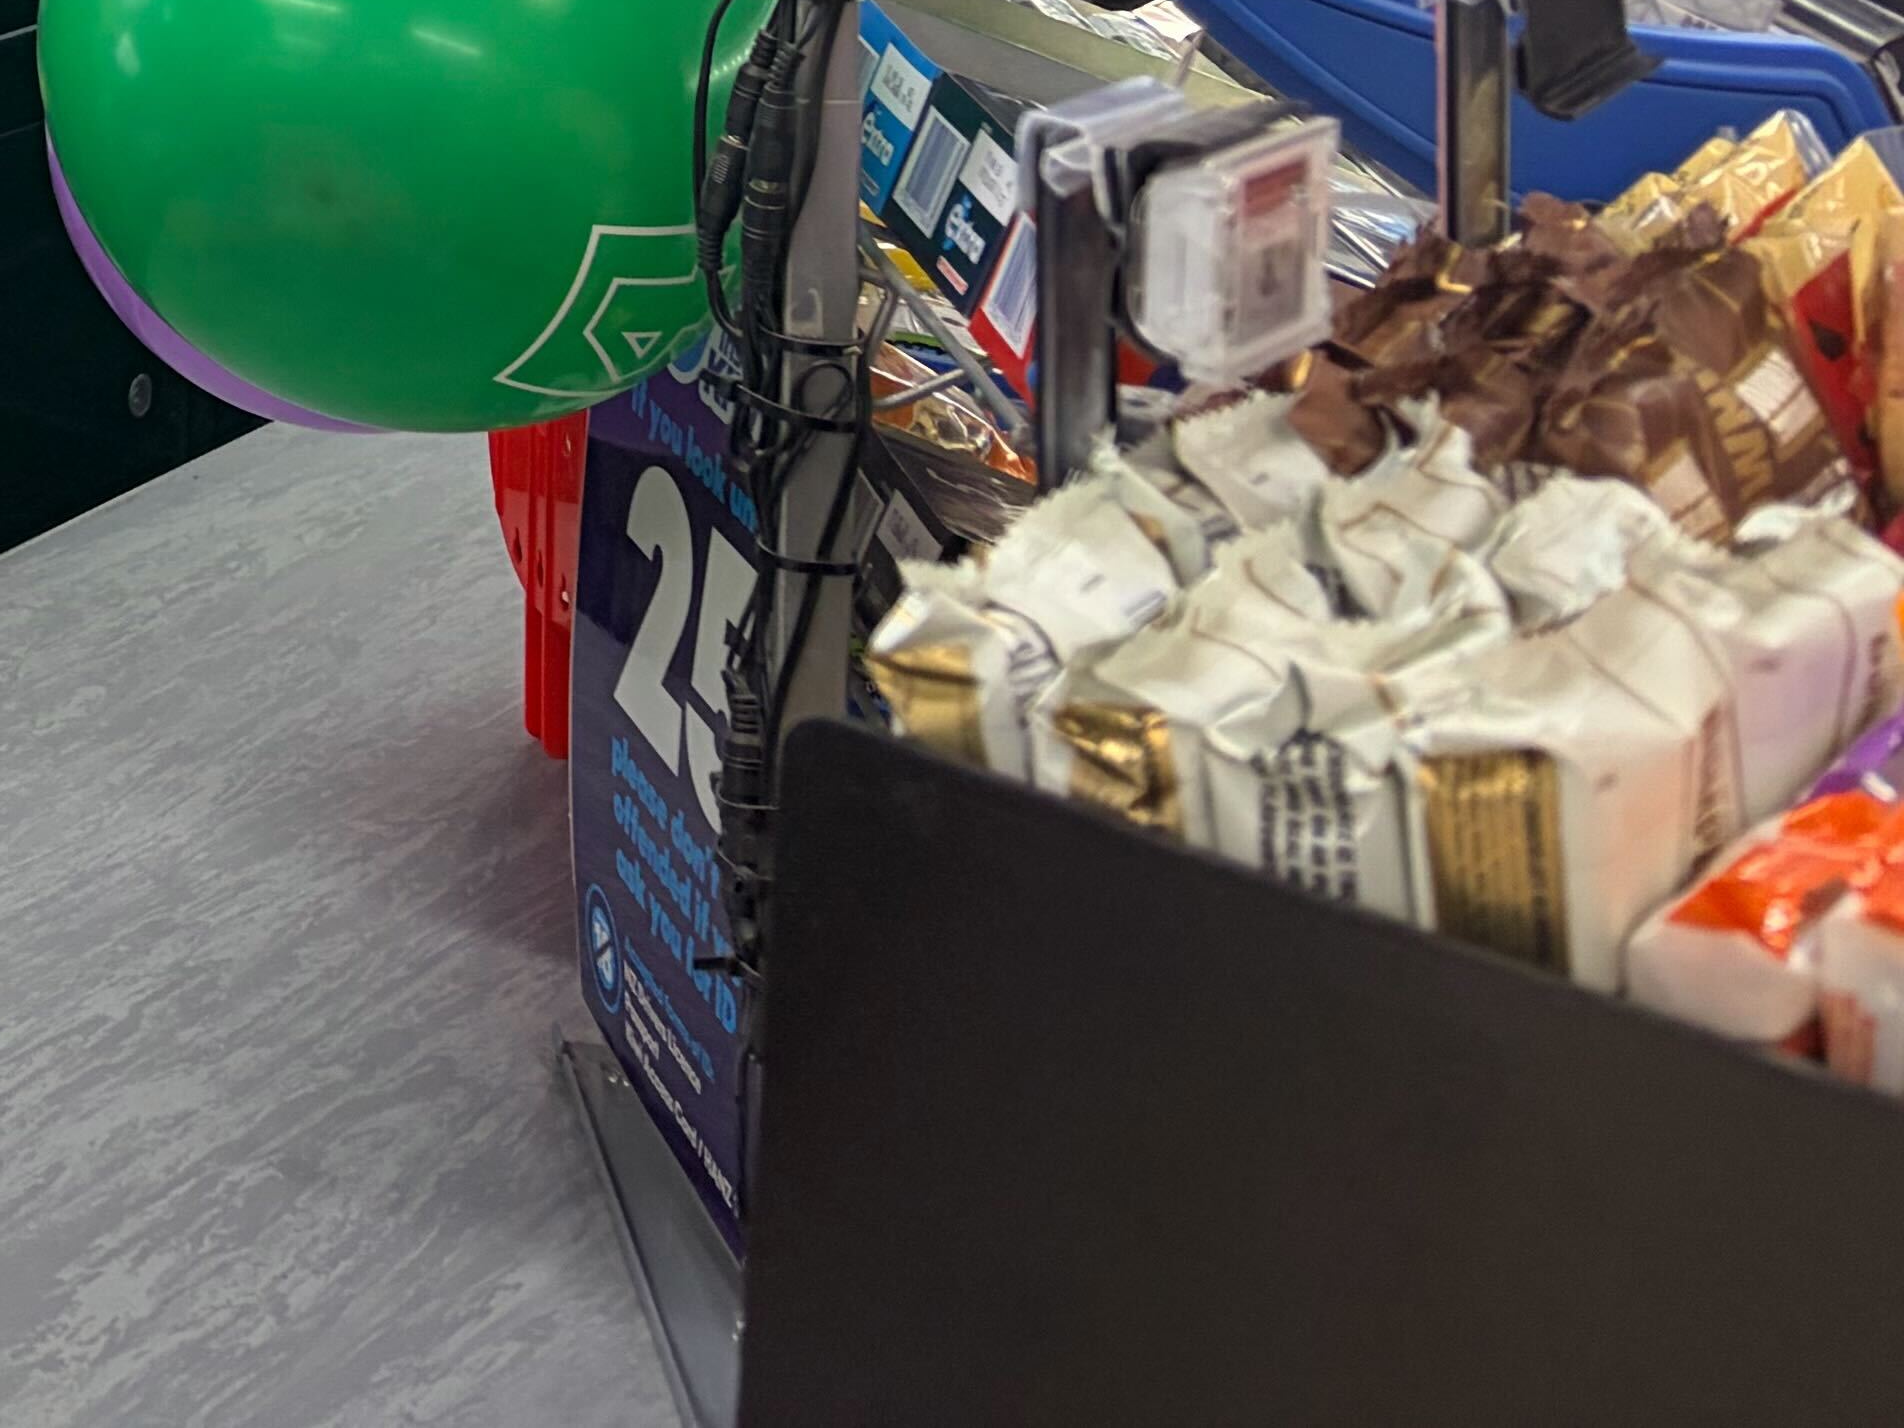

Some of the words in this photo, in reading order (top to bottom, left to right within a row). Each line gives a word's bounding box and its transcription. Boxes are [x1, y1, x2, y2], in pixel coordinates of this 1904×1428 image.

[649, 399, 682, 457] you
[685, 425, 726, 504] look
[611, 736, 667, 831] please
[616, 848, 646, 910] ask
